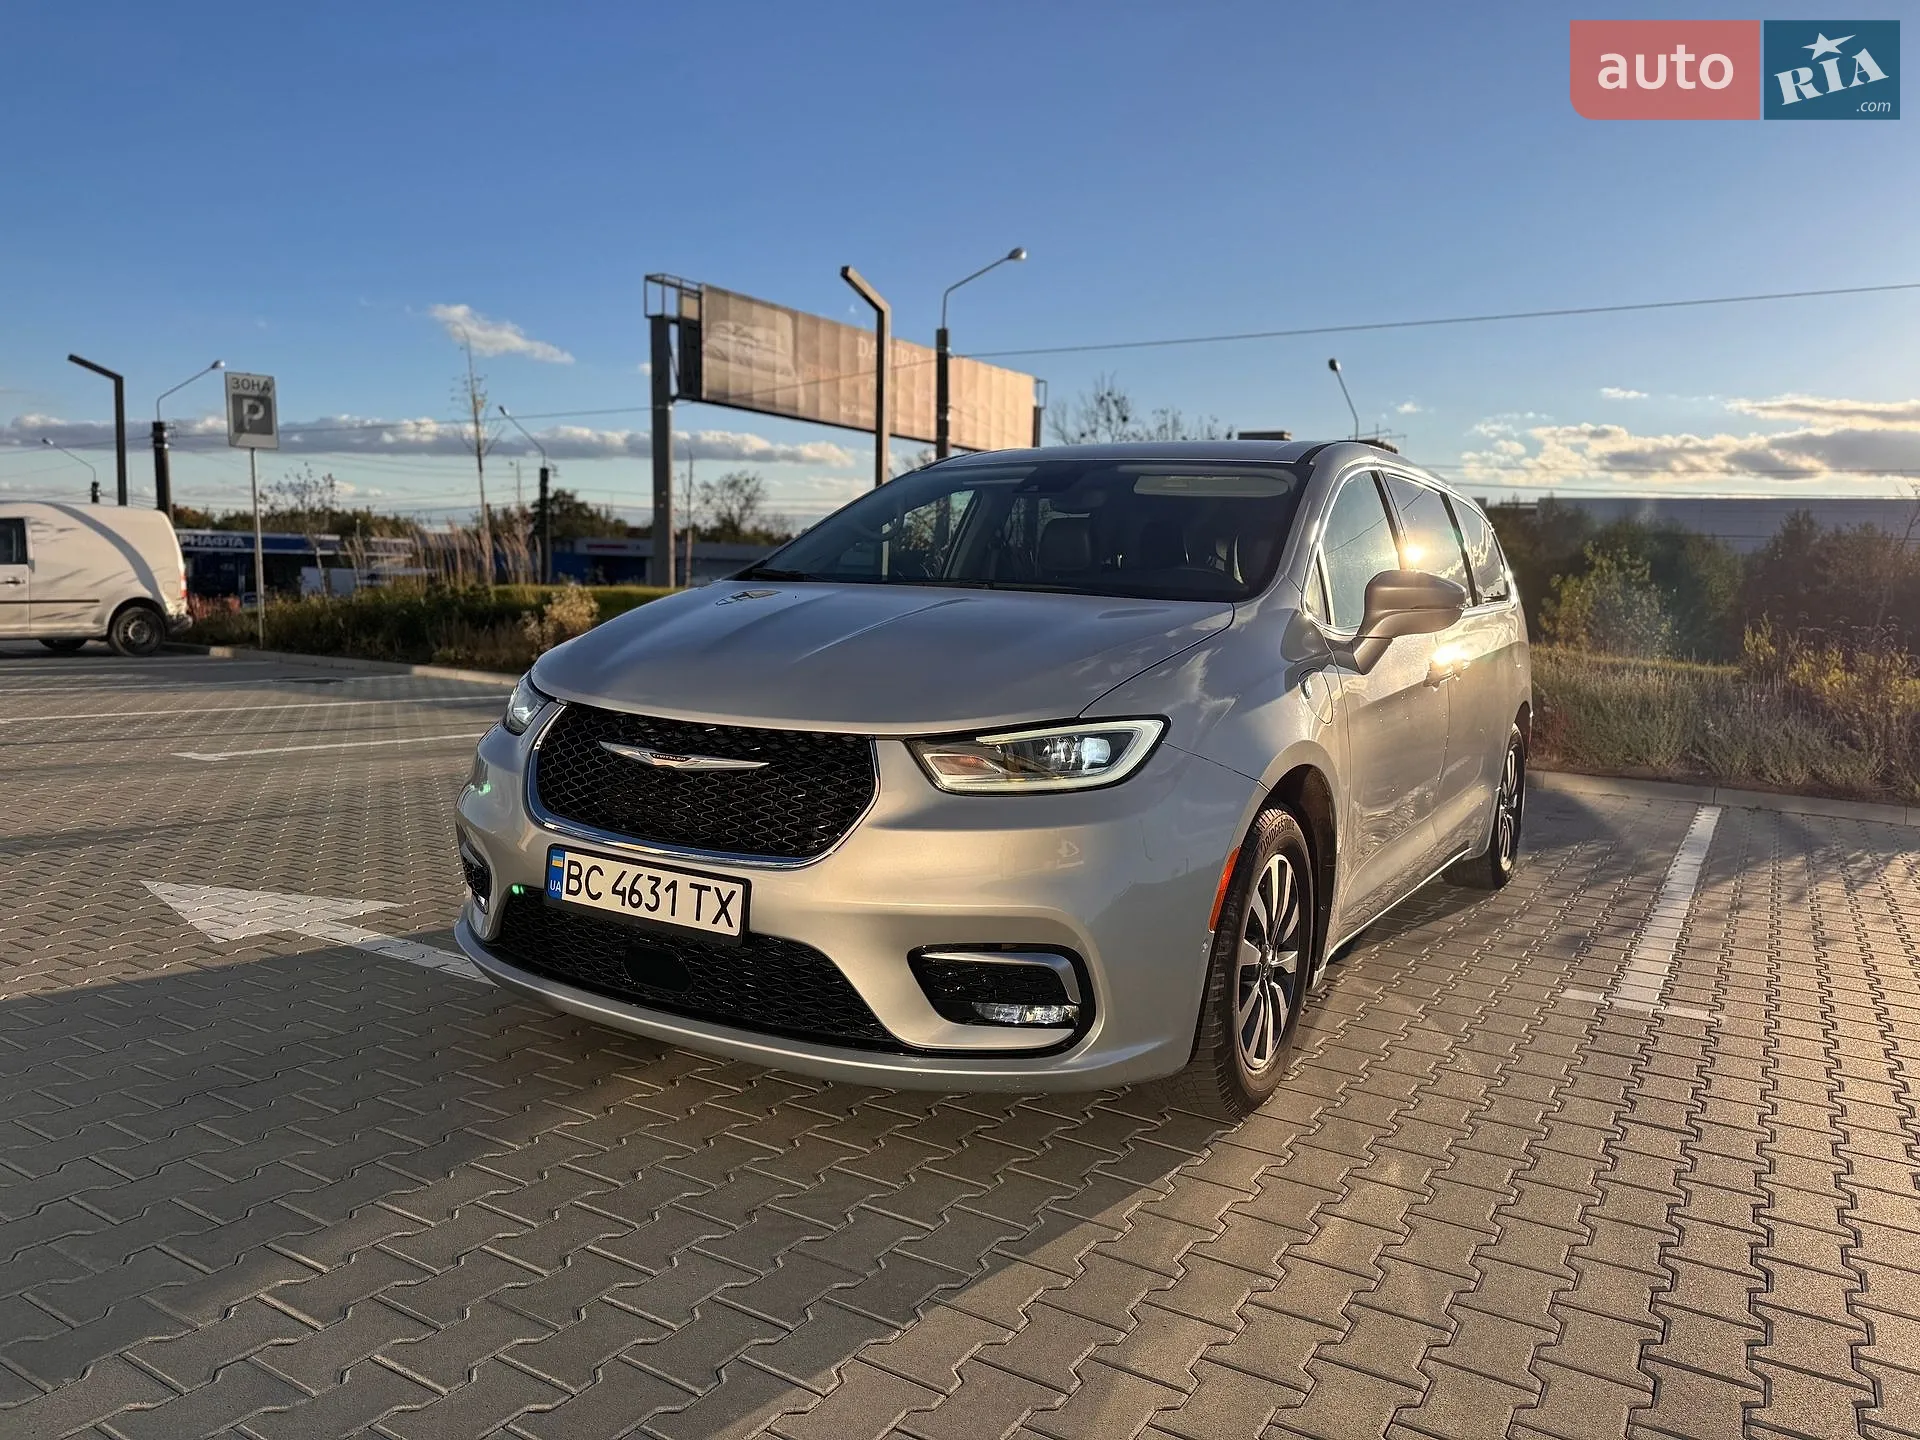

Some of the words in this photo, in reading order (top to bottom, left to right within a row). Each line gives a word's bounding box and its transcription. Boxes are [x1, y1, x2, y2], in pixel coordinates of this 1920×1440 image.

[231, 376, 271, 393] ЗОНА
[242, 398, 265, 432] P
[550, 879, 562, 892] UA
[565, 859, 604, 901] BC
[611, 870, 678, 917] 4631
[689, 882, 737, 928] TX
